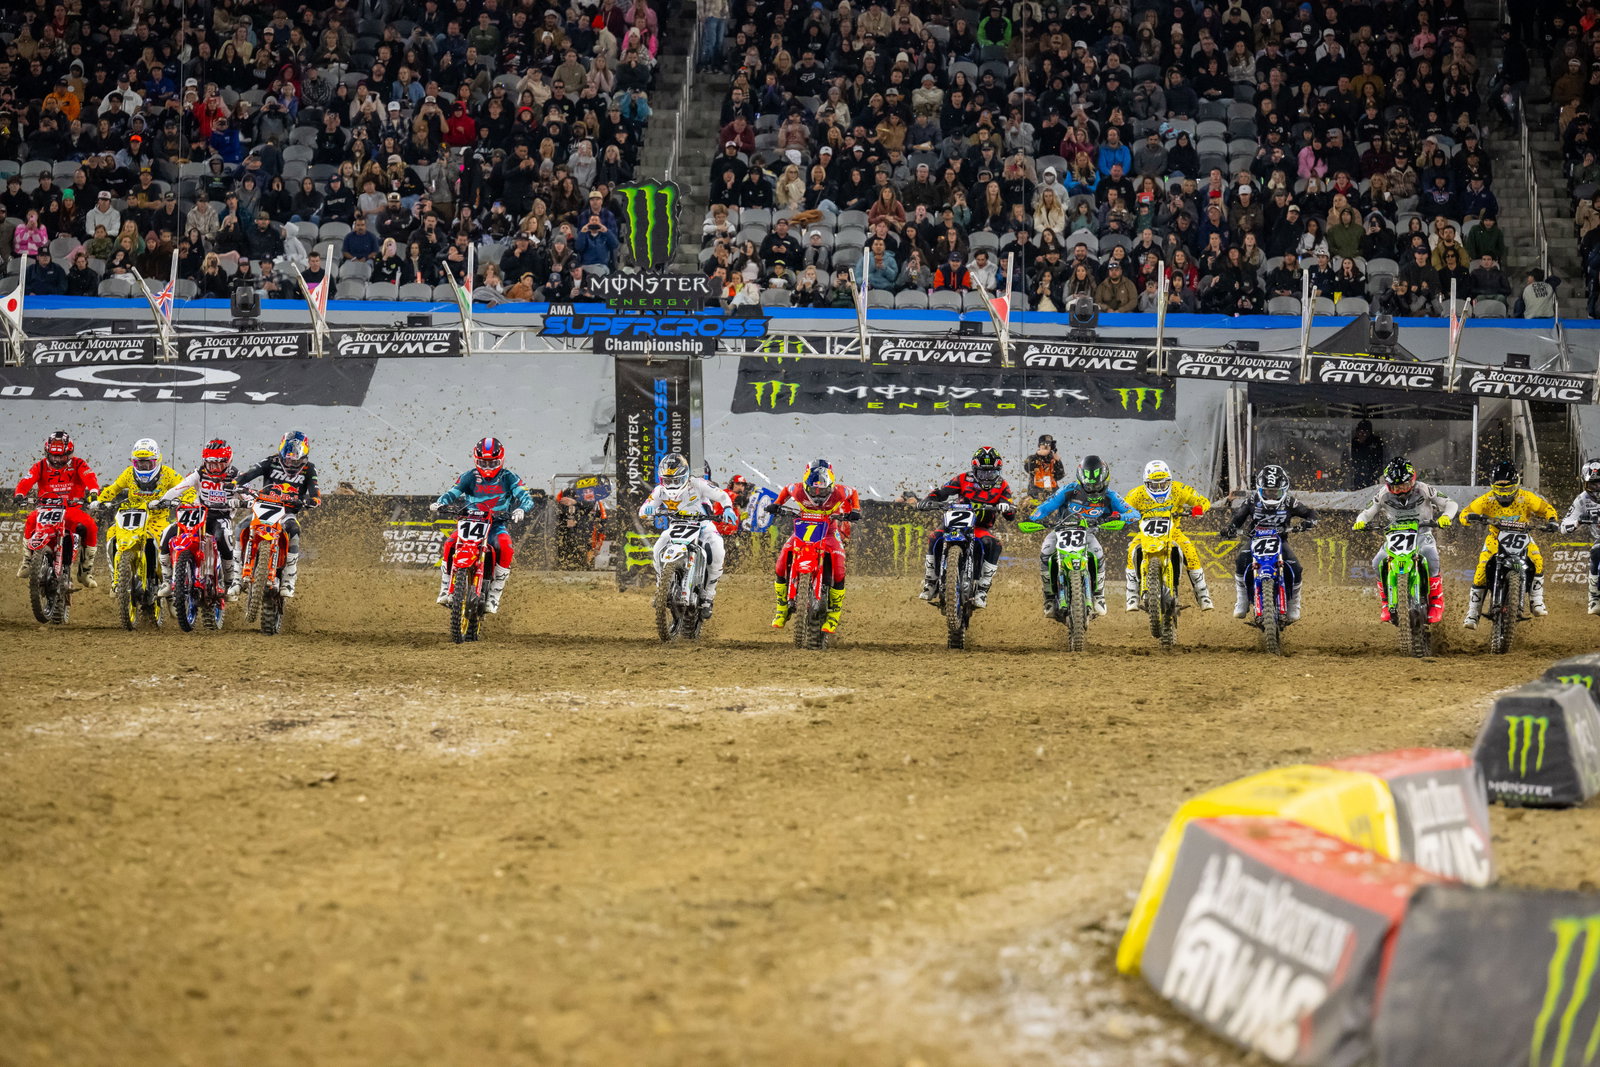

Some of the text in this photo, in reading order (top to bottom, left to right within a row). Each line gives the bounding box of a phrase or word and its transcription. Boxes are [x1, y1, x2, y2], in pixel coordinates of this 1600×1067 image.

[590, 275, 710, 294] MONSTER
[609, 298, 690, 306] ENERGY
[550, 305, 573, 315] AMA
[543, 317, 768, 337] SUPERCROSS
[50, 339, 145, 350] ROCKY MOUNTAIN
[203, 335, 298, 347] ROCKY MOUNTAIN
[354, 332, 450, 342] ROCKY MOUNTAIN
[605, 337, 703, 353] Championship
[897, 339, 993, 351] ROCKY MOUNTAIN
[1042, 344, 1138, 357] ROCKY MOUNTAIN
[1196, 353, 1292, 368] ROCKY MOUNTAIN
[1339, 360, 1434, 375] ROCKY MOUNTAIN
[1488, 371, 1584, 388] ROCKY MOUNTAIN
[1, 385, 278, 401] OAKLEY
[826, 385, 1090, 399] MONSTER
[627, 413, 641, 495] MONSTER
[654, 378, 668, 530] SERCROSS
[39, 512, 61, 523] 148
[179, 509, 204, 527] 49
[259, 504, 286, 520] 7
[945, 511, 971, 527] 2
[122, 513, 142, 527] 11
[1144, 520, 1168, 535] 45
[460, 521, 485, 540] 14
[670, 526, 699, 539] 27
[802, 524, 817, 541] 1
[1058, 531, 1084, 547] 33
[1253, 538, 1279, 555] 43
[1390, 534, 1415, 551] 21
[1501, 534, 1527, 550] 46
[1552, 551, 1590, 561] SUP
[1555, 562, 1588, 572] MO
[1550, 573, 1588, 583] CRO
